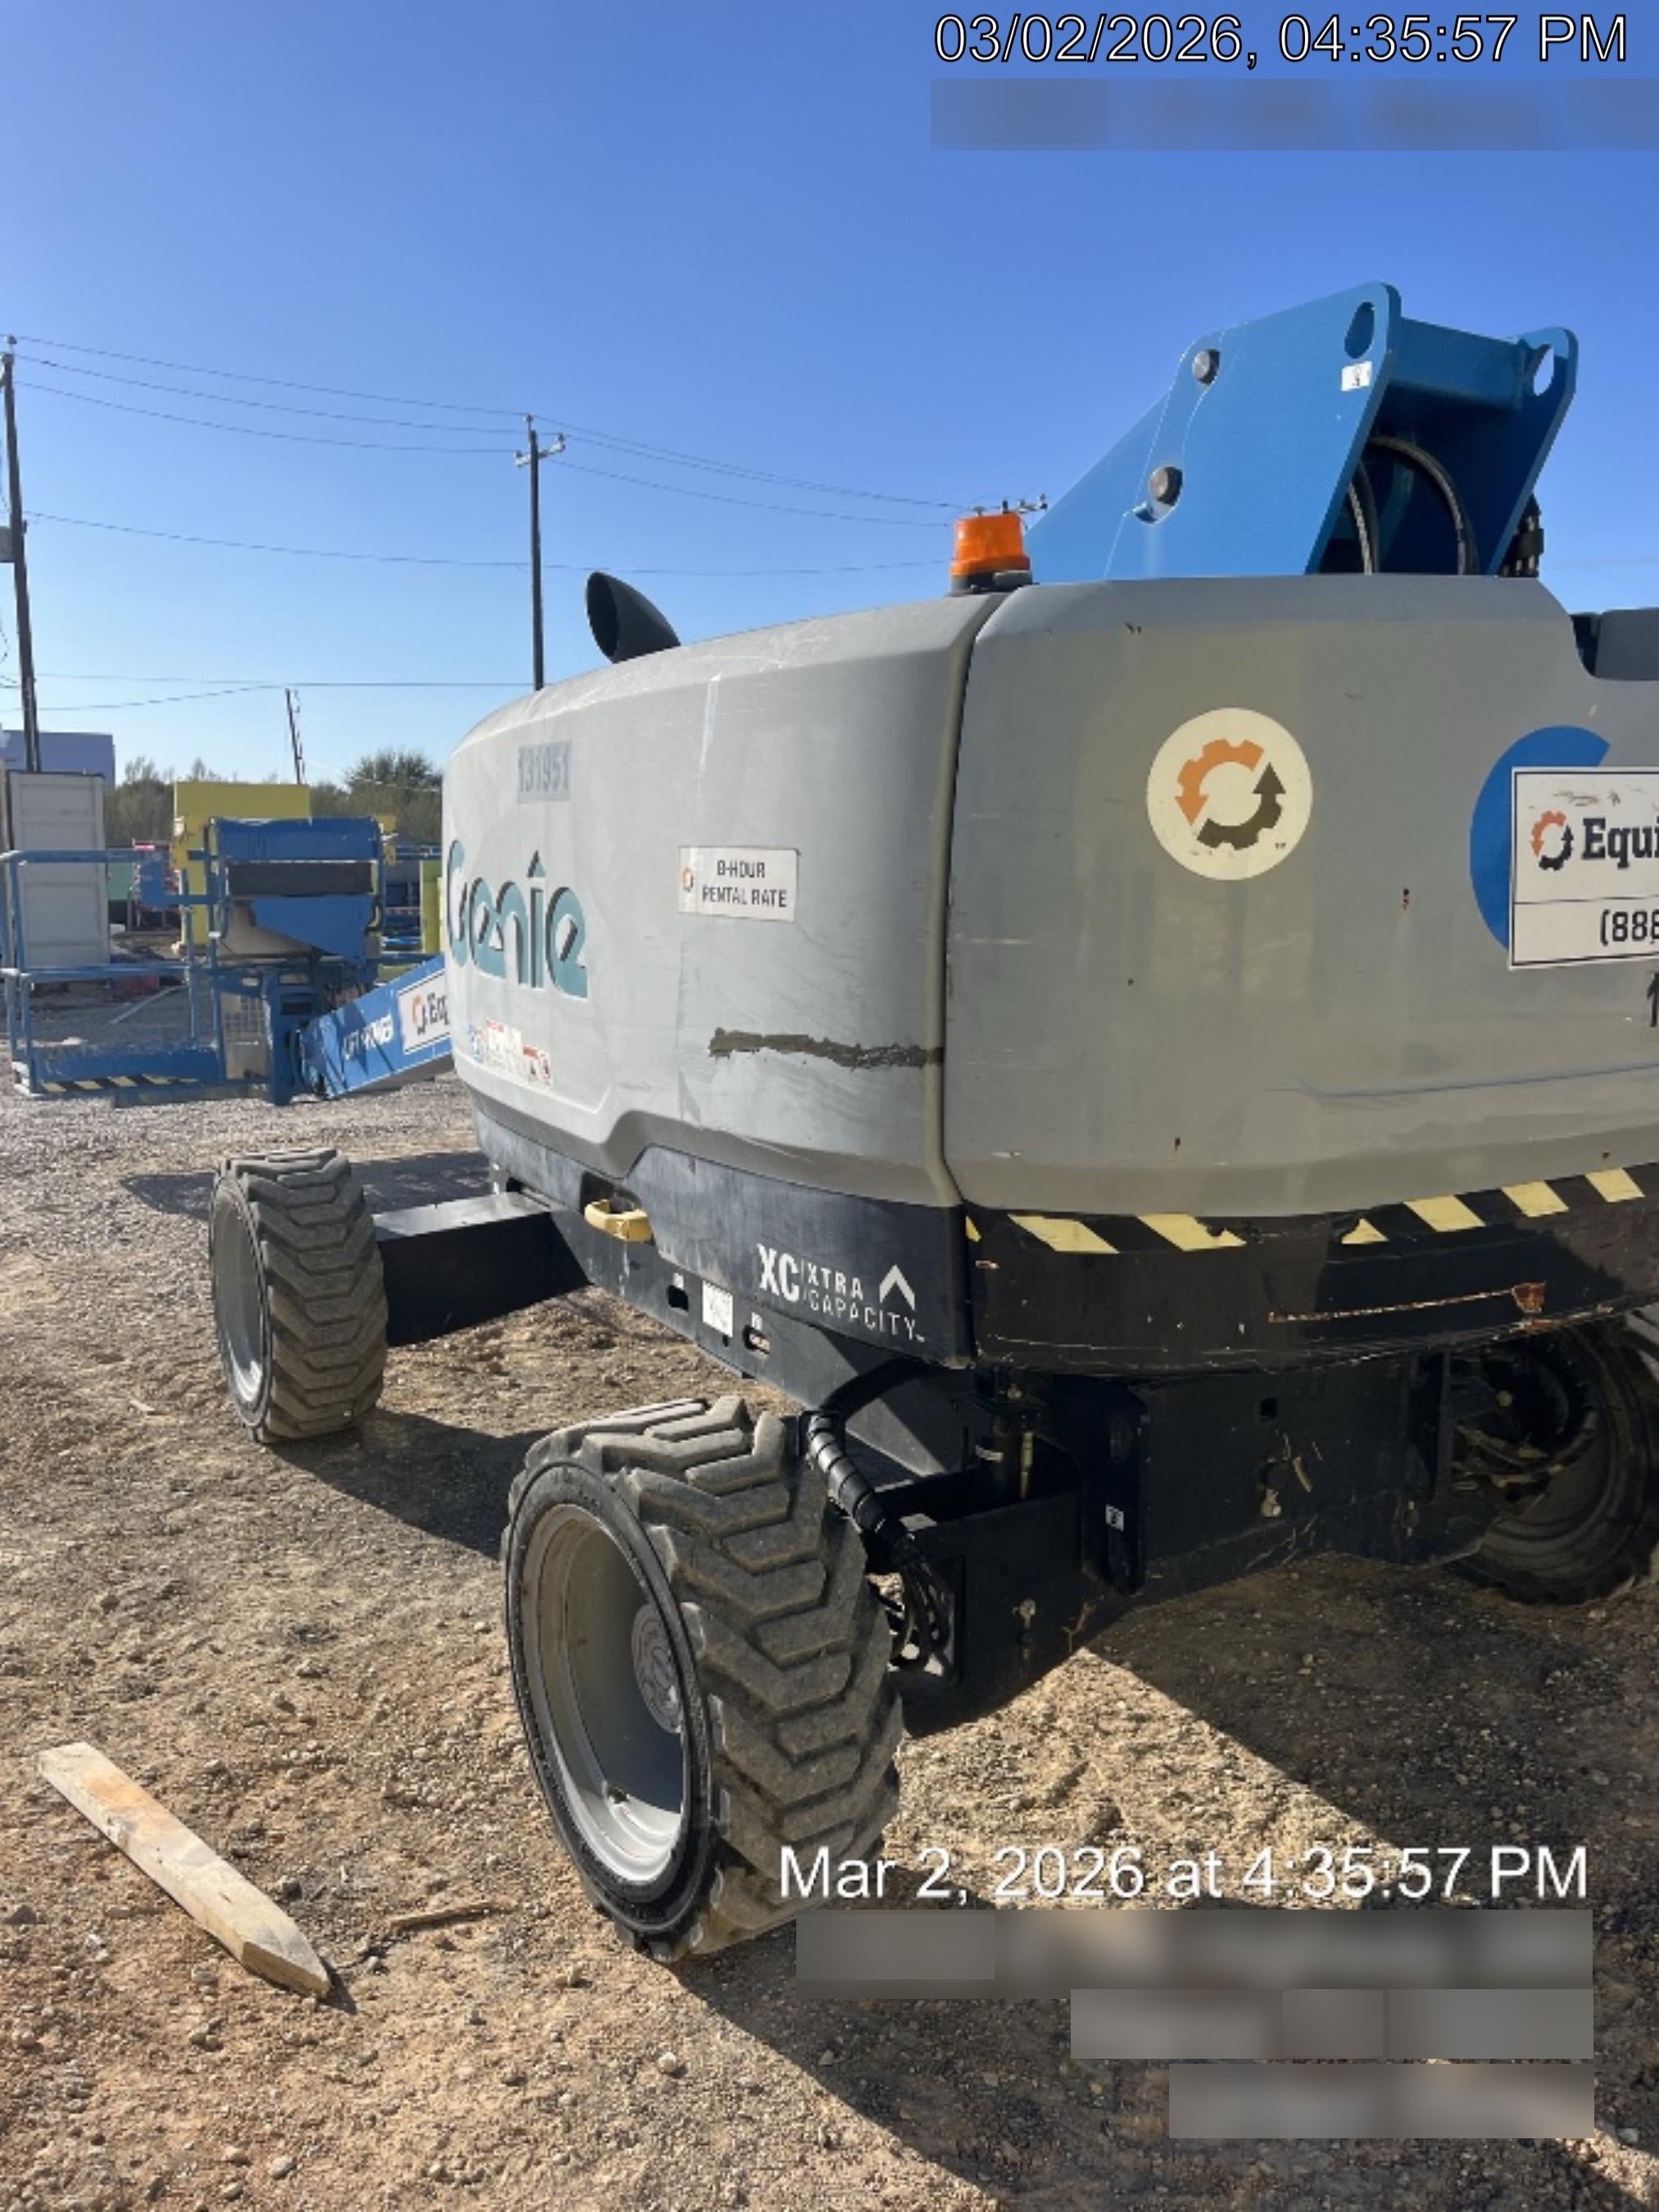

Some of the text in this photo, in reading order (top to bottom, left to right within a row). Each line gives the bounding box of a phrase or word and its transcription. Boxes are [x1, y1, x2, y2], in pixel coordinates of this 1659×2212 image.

[447, 839, 587, 999] Genie
[702, 884, 787, 909] RENTAL RATE
[757, 1243, 800, 1303] XC
[807, 1262, 863, 1301] XTRA
[809, 1289, 916, 1340] CAPACITY
